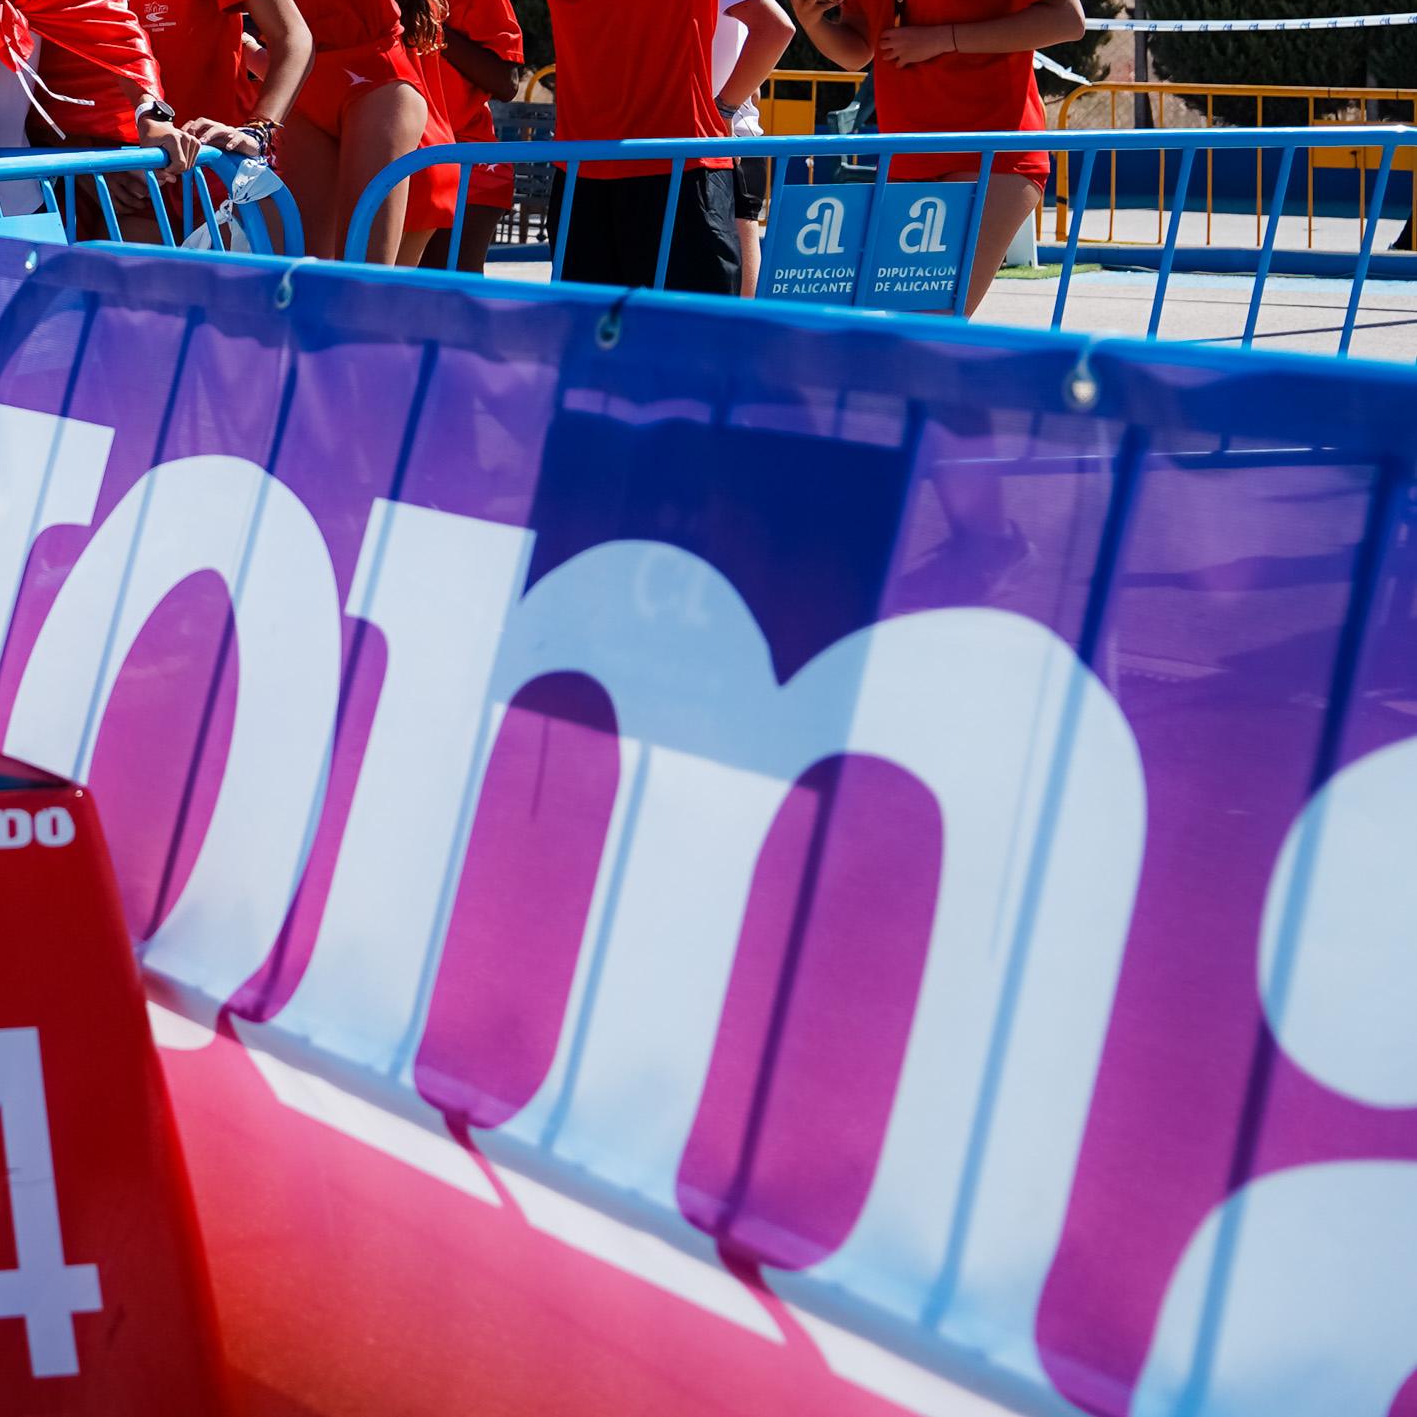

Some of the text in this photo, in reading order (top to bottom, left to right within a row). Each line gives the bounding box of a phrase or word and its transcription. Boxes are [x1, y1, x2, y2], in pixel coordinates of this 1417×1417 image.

[772, 282, 853, 294] DE ALICANTE
[874, 280, 955, 292] DE ALICANTE
